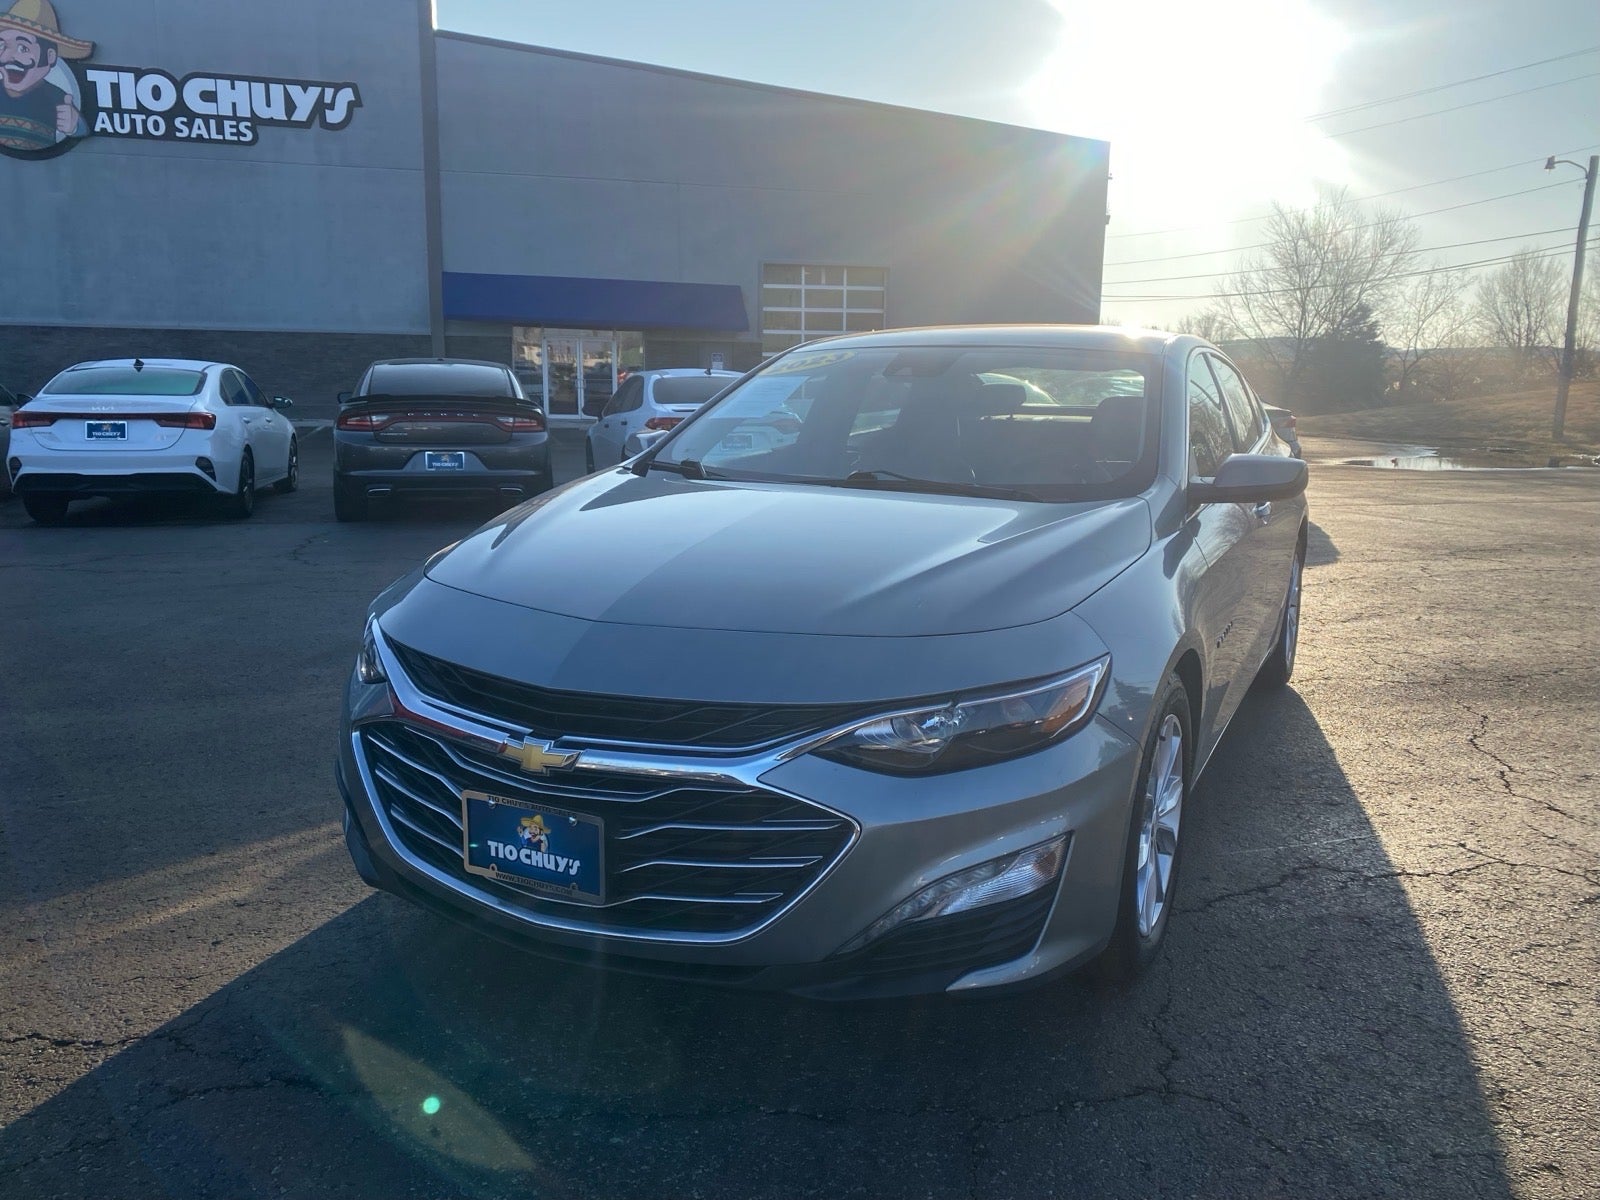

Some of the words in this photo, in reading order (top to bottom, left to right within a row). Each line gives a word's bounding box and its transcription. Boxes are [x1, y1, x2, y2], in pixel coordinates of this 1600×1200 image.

[86, 69, 177, 112] TIO
[182, 77, 356, 124] CHUY'S
[94, 111, 165, 136] AUTO
[175, 117, 253, 142] SALES
[487, 839, 518, 861] TIO
[519, 848, 581, 876] CHUY'S
